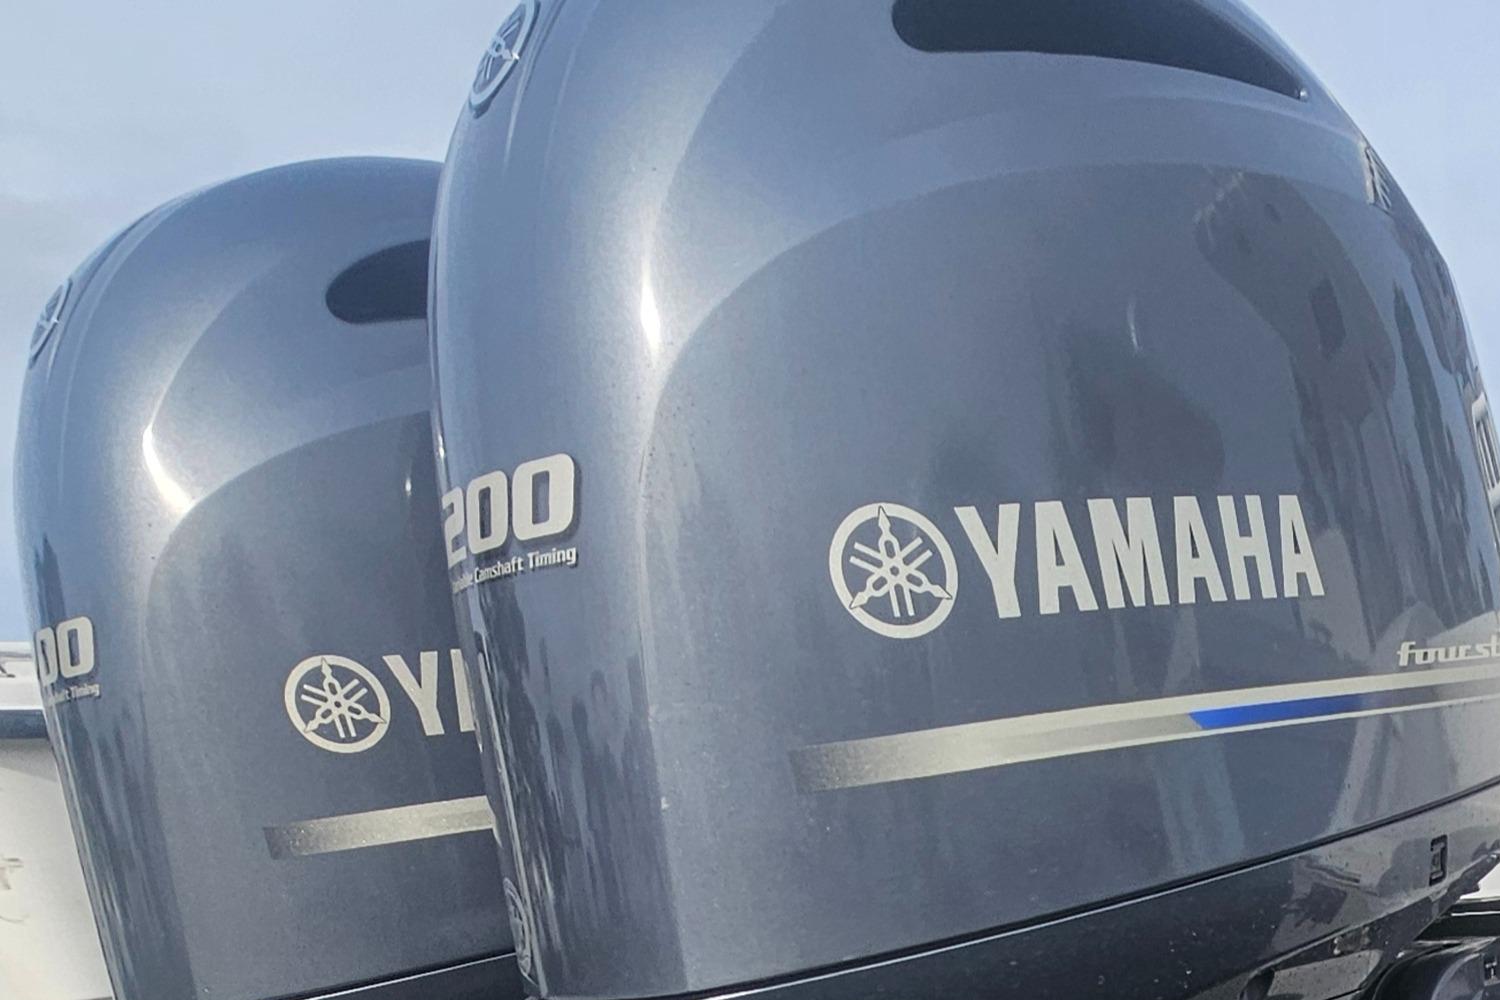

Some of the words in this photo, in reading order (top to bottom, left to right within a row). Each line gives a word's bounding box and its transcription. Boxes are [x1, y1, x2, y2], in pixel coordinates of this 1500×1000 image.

[442, 453, 575, 570] 200
[474, 556, 524, 584] Camshaft
[527, 547, 577, 570] Timing
[954, 494, 1325, 618] YAMAHA
